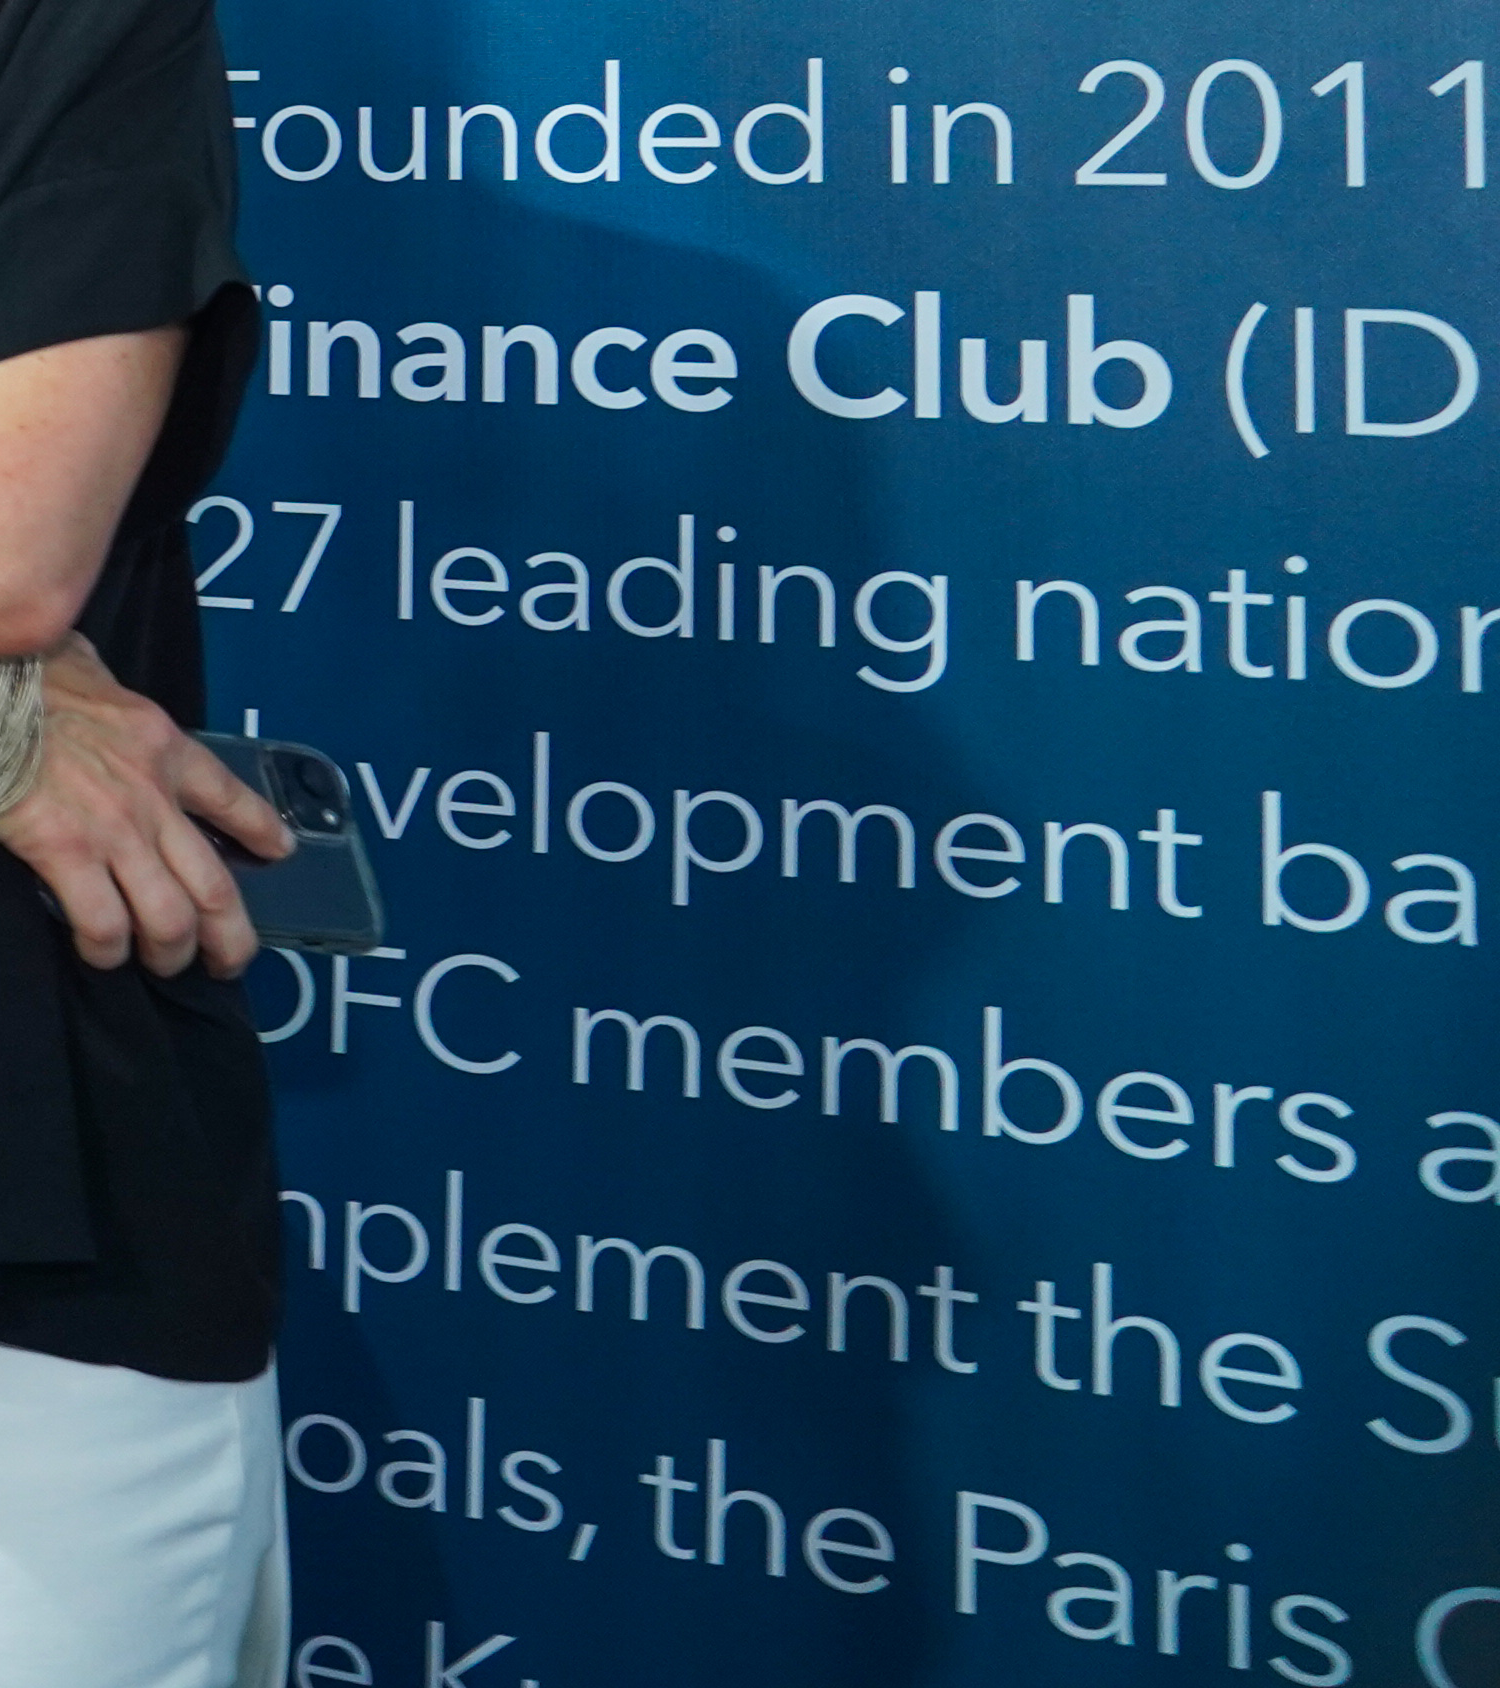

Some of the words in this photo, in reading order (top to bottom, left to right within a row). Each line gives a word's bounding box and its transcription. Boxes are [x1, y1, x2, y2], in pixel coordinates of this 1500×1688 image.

[887, 66, 1015, 186] in
[1073, 57, 1486, 191] 2011
[252, 284, 738, 413] inance
[786, 289, 1173, 429] Club
[1225, 300, 1481, 460] (ID
[185, 495, 342, 613] 27
[396, 499, 950, 694] leading
[243, 708, 1204, 919] velopment
[1260, 789, 1480, 948] ba
[571, 1006, 1358, 1184] members
[1416, 1111, 1500, 1206] a
[1016, 1262, 1302, 1425] the
[1365, 1314, 1500, 1456] S
[284, 1396, 599, 1563] oals,
[639, 1438, 894, 1596] the
[955, 1490, 1355, 1688] Paris
